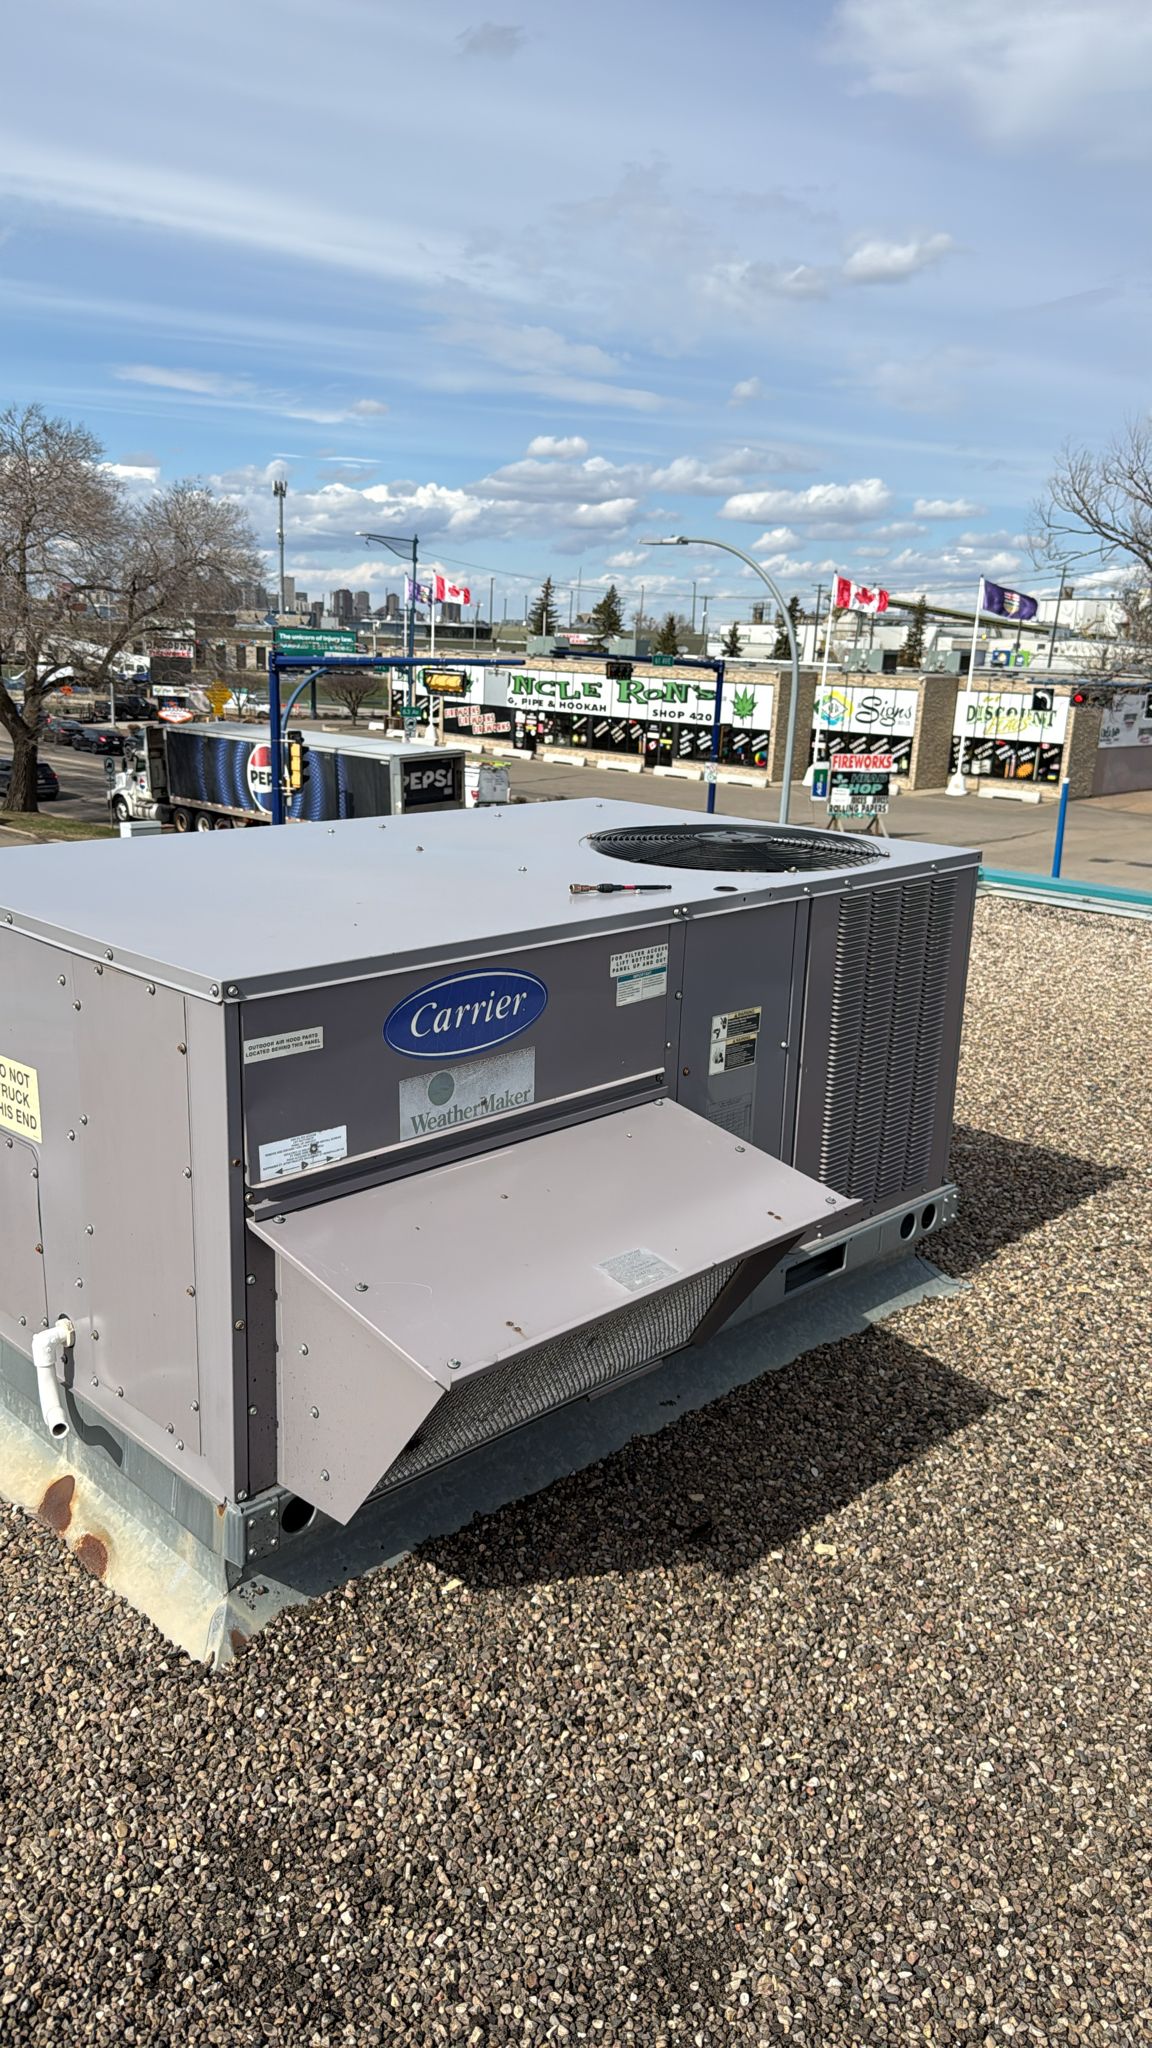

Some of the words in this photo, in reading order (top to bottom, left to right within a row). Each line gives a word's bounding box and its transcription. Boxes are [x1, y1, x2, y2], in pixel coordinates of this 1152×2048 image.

[508, 672, 602, 700] NCLE
[521, 698, 543, 707] PIPE
[548, 700, 556, 708] &
[559, 701, 607, 712] HOOKAH
[855, 696, 912, 727] Signs
[652, 709, 685, 719] SHOP
[689, 712, 712, 721] 420
[833, 755, 892, 768] FIREWORKS
[251, 769, 272, 786] PEP
[829, 804, 859, 814] ROLLING
[861, 804, 887, 814] PAPERS
[625, 950, 645, 958] FILTER
[632, 954, 654, 963] BOTTOM
[410, 990, 527, 1038] Carrier
[245, 1048, 270, 1058] LOCATED
[271, 1044, 291, 1052] BEHIND
[304, 1038, 321, 1046] PANEL
[248, 1041, 274, 1051] OUTDOOR
[0, 1063, 6, 1078] O
[9, 1067, 30, 1088] NOT
[1, 1083, 30, 1108] RUCK
[0, 1102, 13, 1119] HIS
[16, 1108, 37, 1130] END
[411, 1088, 531, 1135] WeatherMaker
